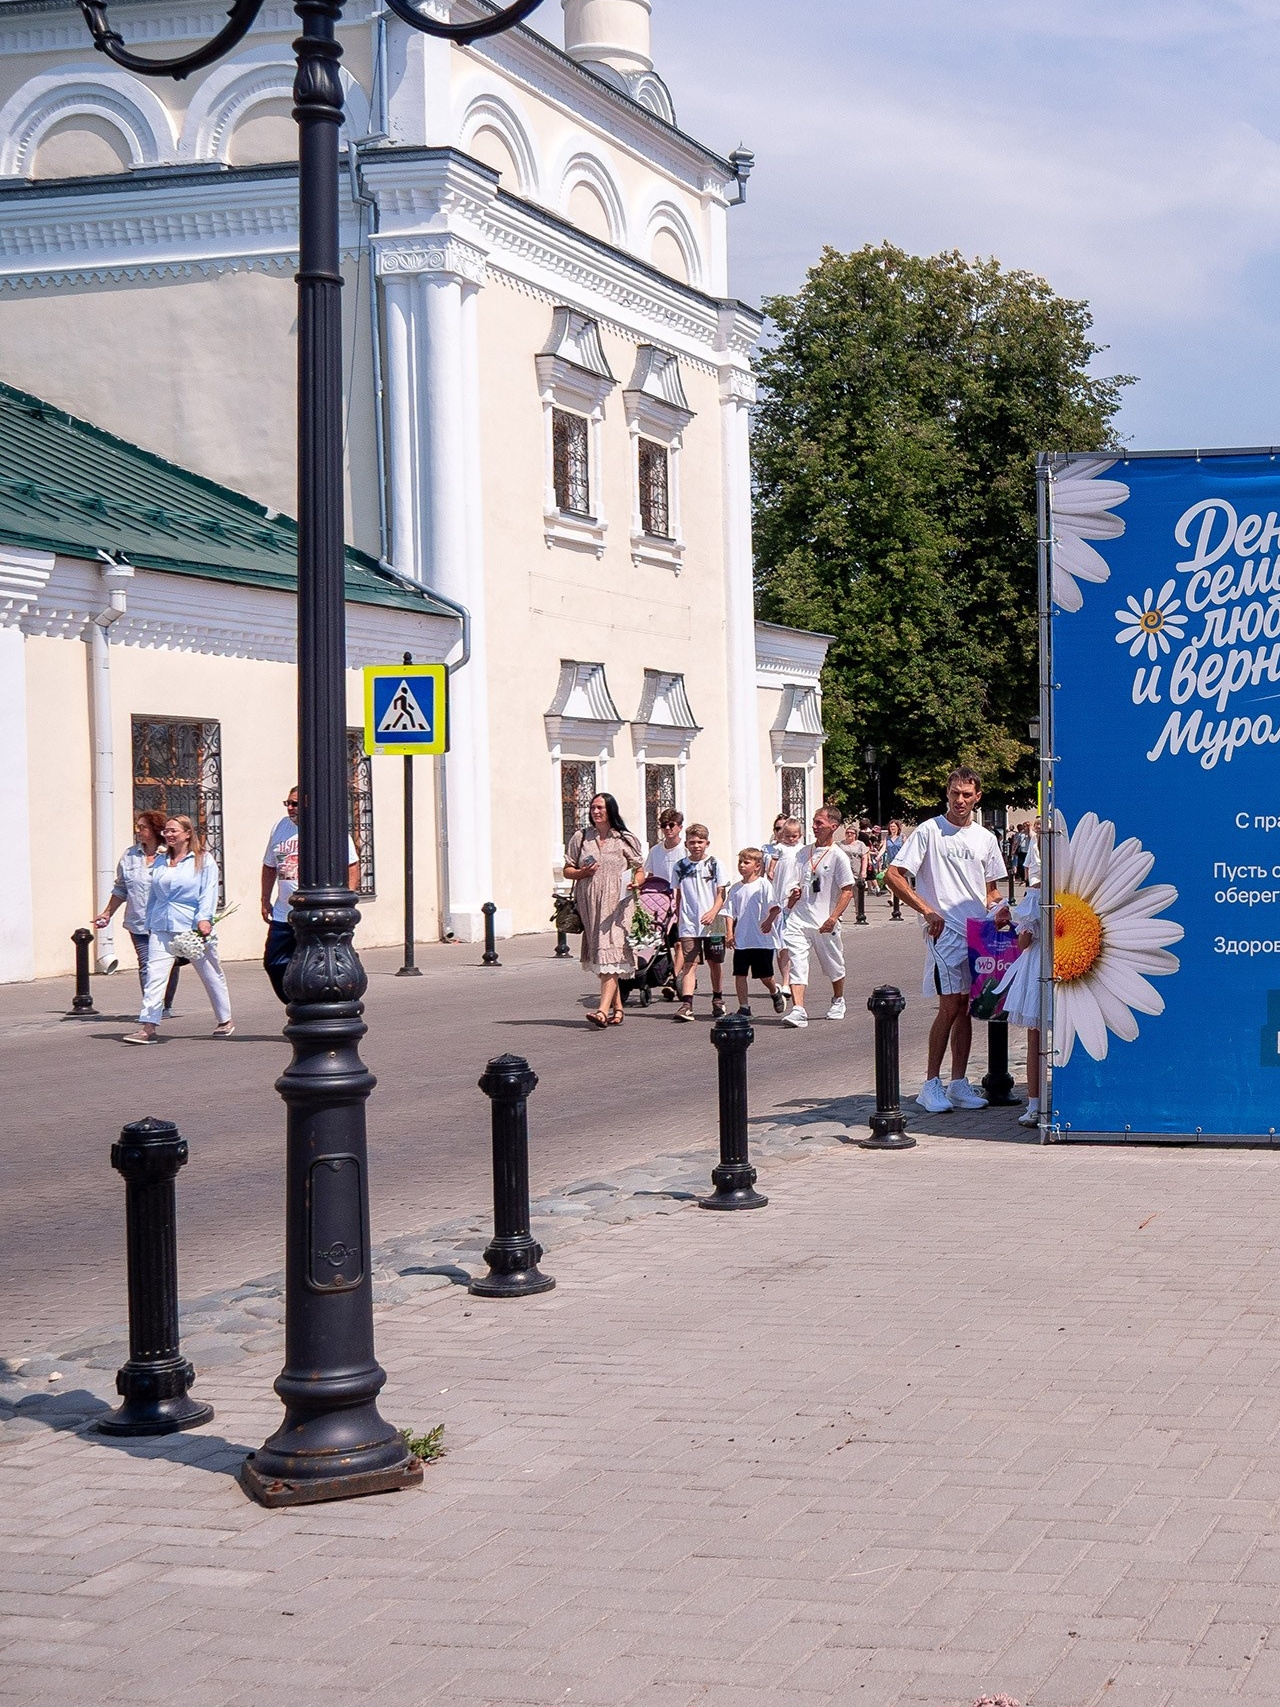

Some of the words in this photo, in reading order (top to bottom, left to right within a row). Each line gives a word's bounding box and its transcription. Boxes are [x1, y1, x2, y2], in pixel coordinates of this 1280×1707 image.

[1132, 665, 1162, 705] и
[1235, 812, 1250, 829] С
[947, 847, 975, 860] RUN
[1213, 862, 1268, 882] Пусть
